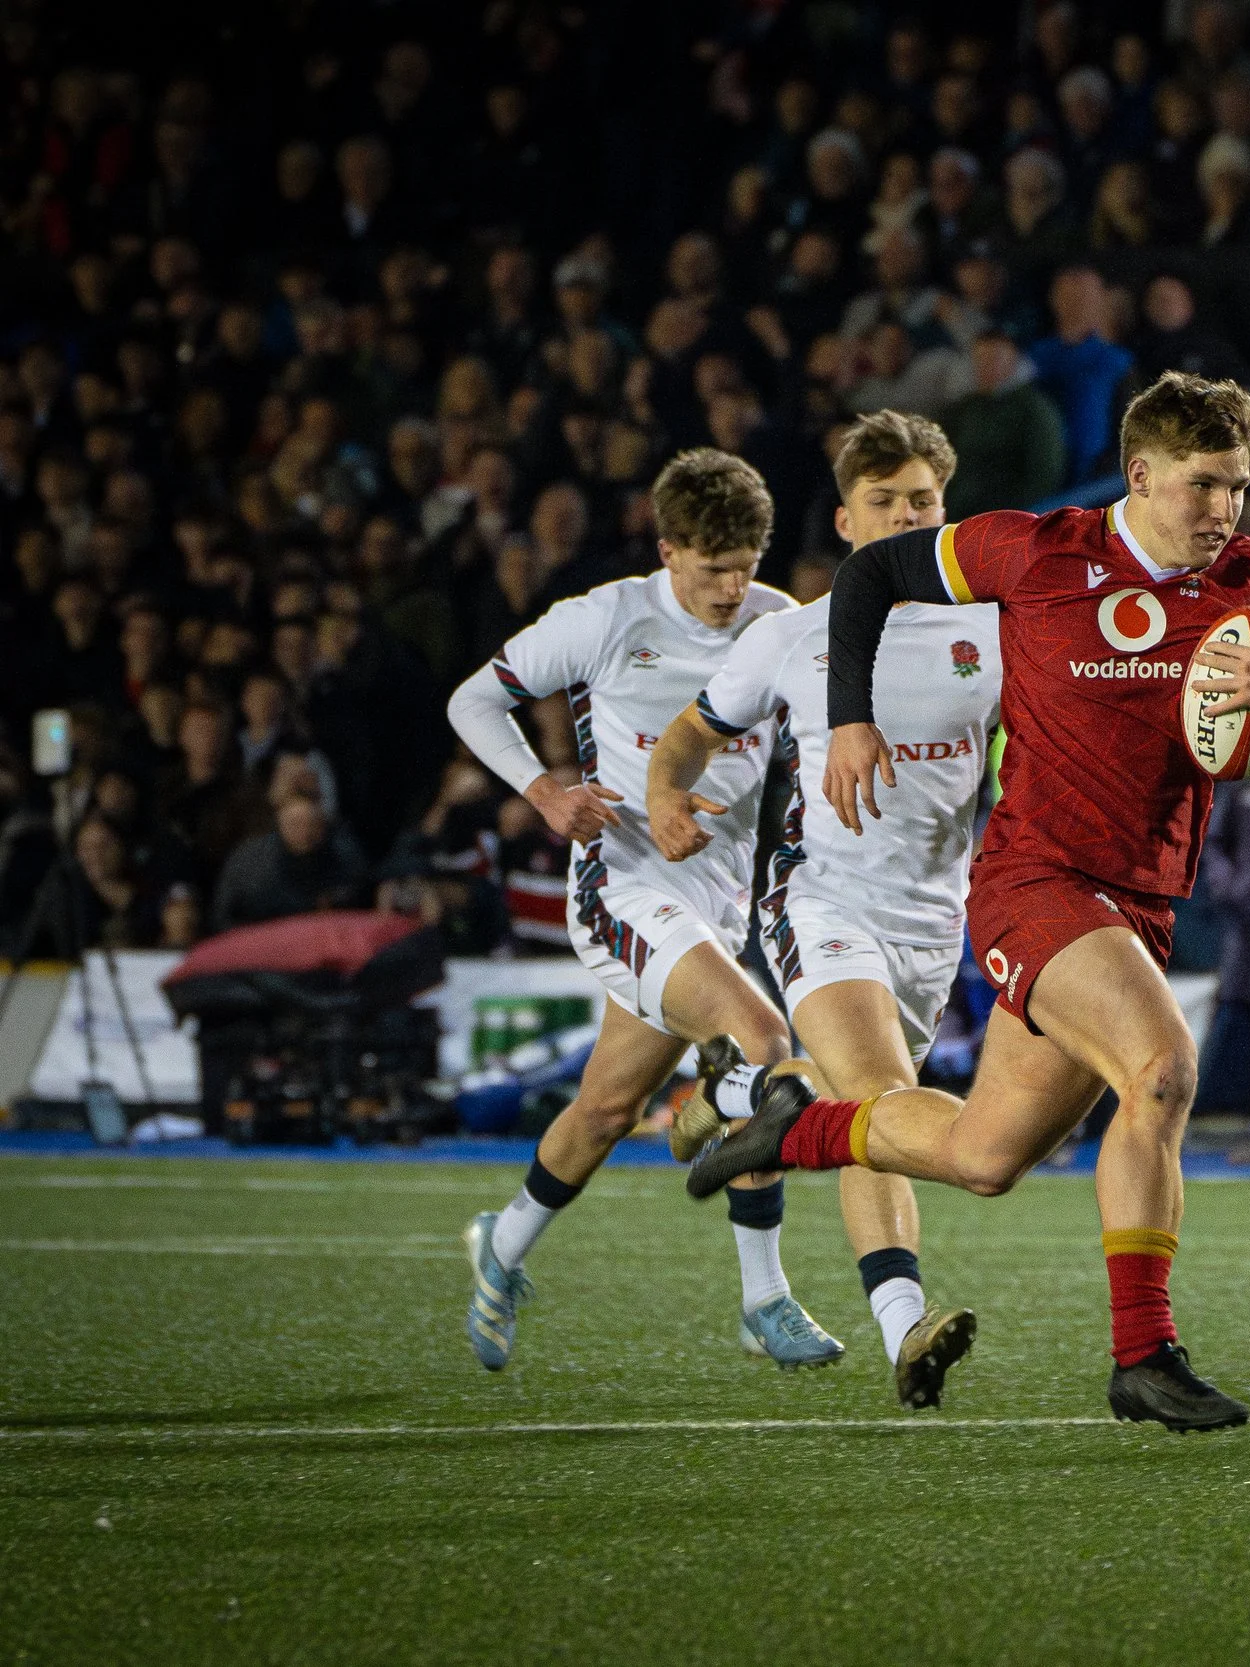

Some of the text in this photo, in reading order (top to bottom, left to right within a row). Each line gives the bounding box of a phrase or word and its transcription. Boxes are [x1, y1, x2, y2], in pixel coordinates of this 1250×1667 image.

[1179, 587, 1200, 599] U-20
[1069, 657, 1183, 679] vodafone
[1197, 628, 1239, 765] GBERT
[635, 732, 760, 754] HDA
